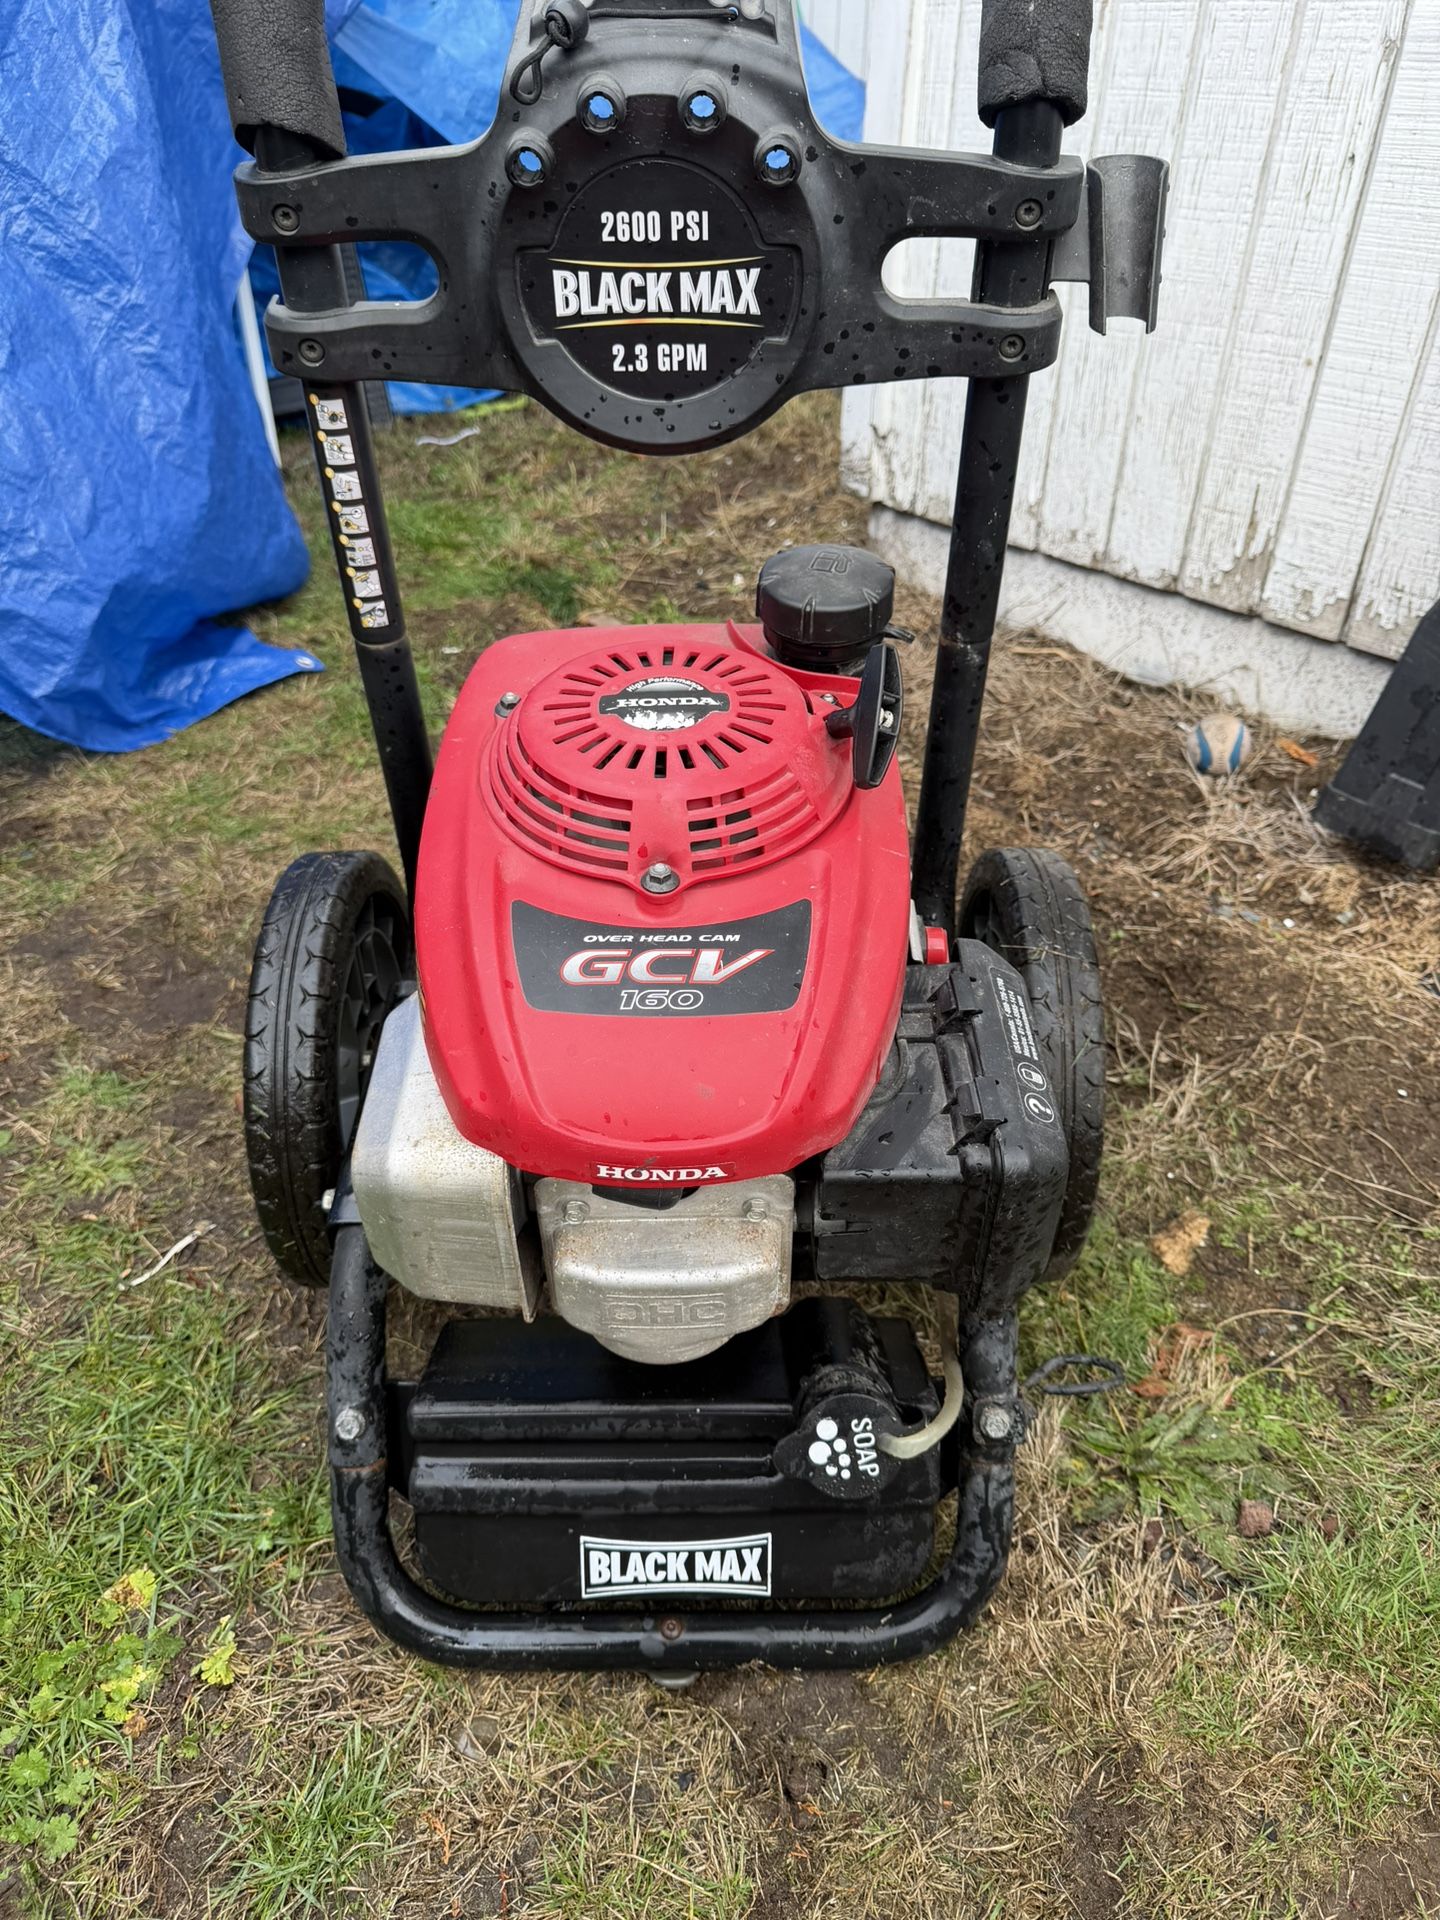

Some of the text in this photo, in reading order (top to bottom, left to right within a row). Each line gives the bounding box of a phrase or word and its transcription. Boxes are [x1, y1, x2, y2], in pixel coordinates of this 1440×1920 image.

[600, 210, 709, 242] 2600 PSI
[552, 267, 761, 318] BLACK MAX
[612, 343, 707, 372] 2.3 GPM
[626, 681, 646, 692] High
[616, 697, 719, 708] HONDA
[583, 934, 740, 943] OVER HEAD CAM
[560, 948, 775, 985] GCV
[620, 989, 704, 1010] 160
[596, 1165, 728, 1181] HONDA
[607, 1301, 726, 1323] OHC
[851, 1417, 880, 1477] SOAP
[589, 1547, 762, 1585] BLACK MAX
